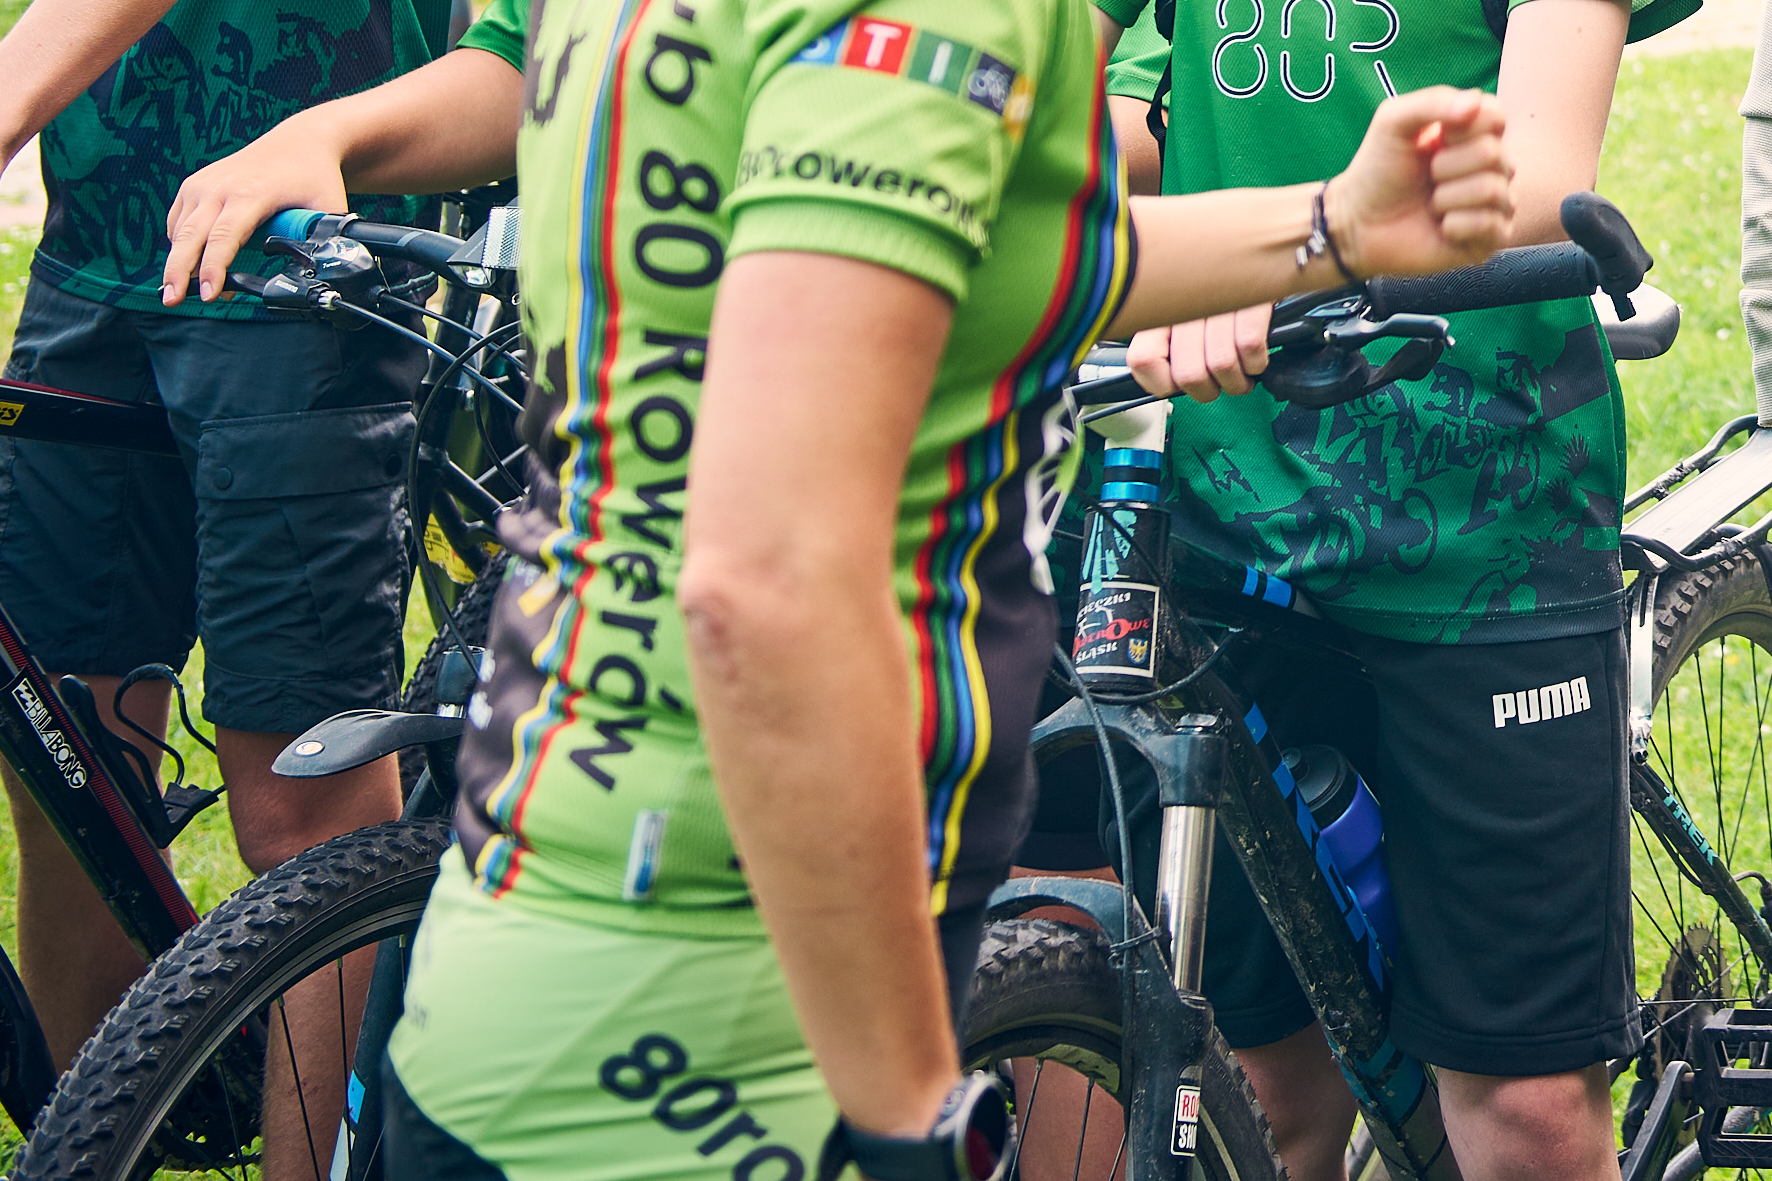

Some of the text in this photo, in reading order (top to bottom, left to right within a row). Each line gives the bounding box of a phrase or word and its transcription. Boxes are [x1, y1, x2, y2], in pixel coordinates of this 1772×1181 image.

[634, 149, 725, 289] 80
[567, 327, 710, 793] Rowerów
[26, 697, 87, 789] BILLABONG
[1492, 676, 1592, 729] PUMA
[1663, 786, 1719, 867] TREK
